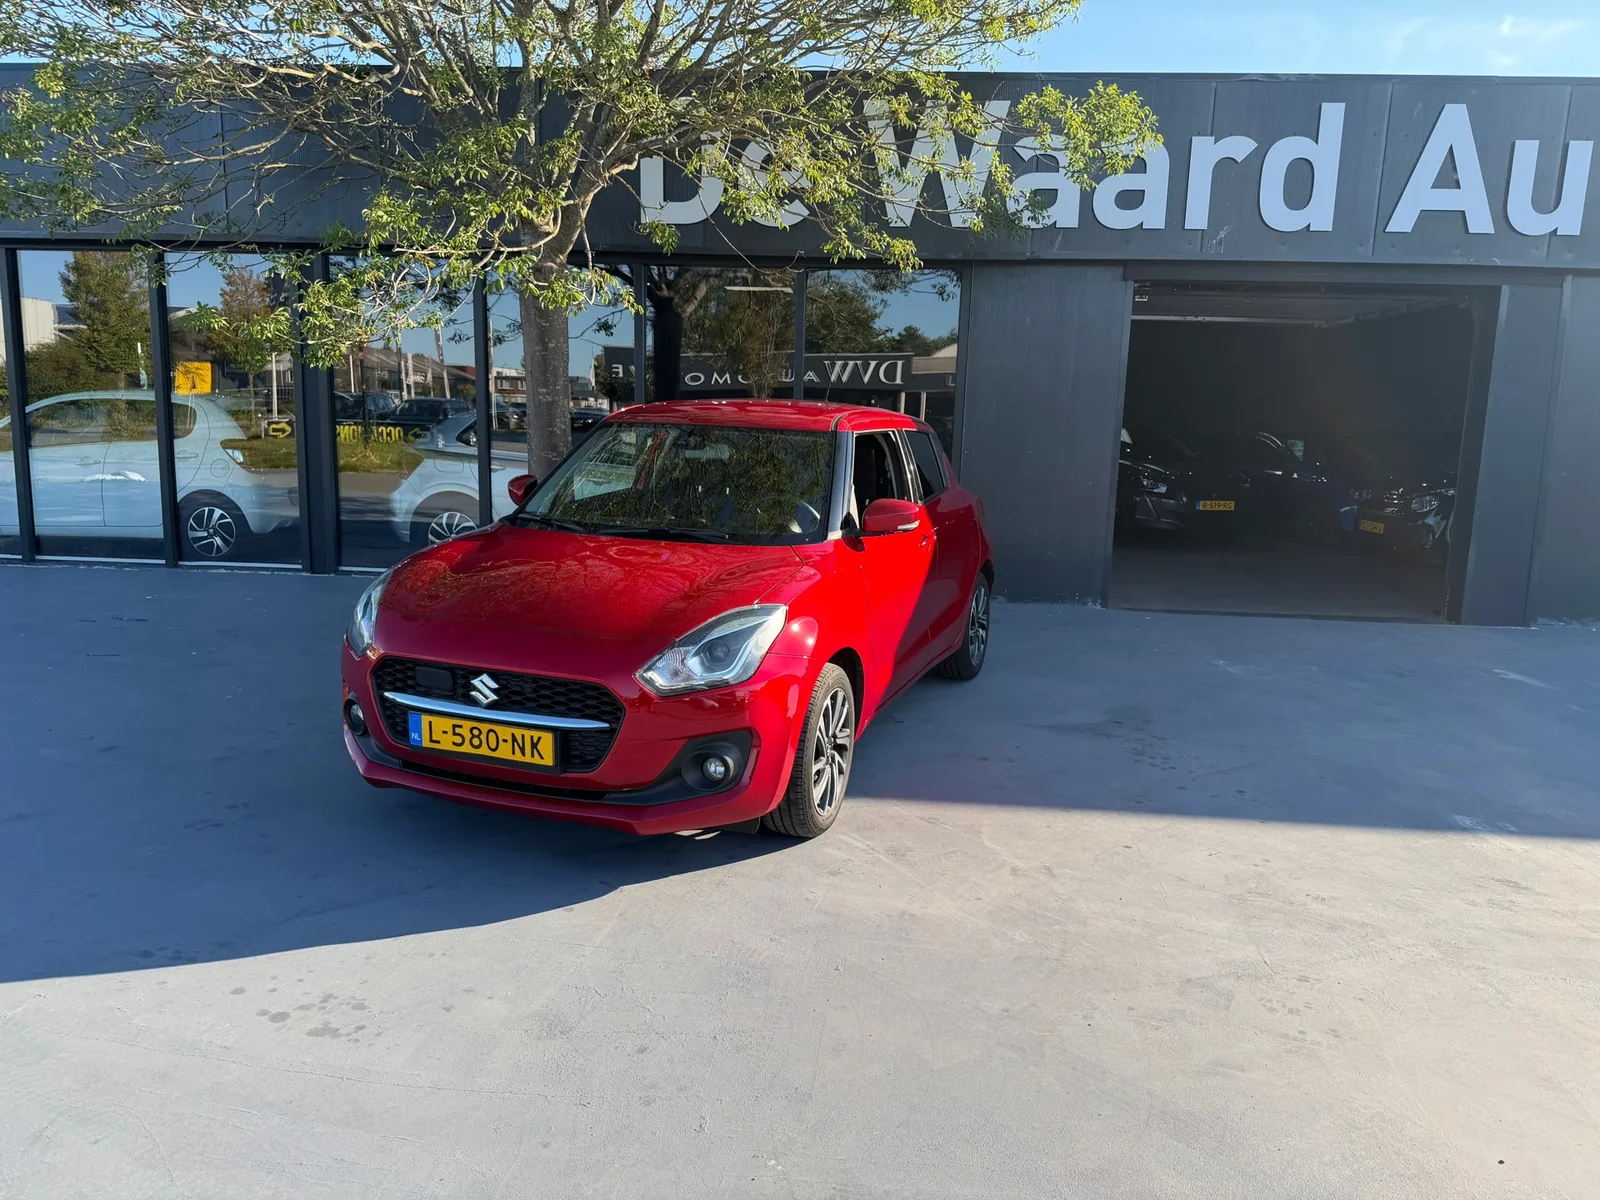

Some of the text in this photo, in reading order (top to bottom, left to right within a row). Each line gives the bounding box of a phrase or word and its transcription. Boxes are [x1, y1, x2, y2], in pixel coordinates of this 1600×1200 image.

[863, 99, 1346, 232] Waard
[1385, 103, 1594, 236] Au
[411, 720, 545, 761] NL L-580-NK
